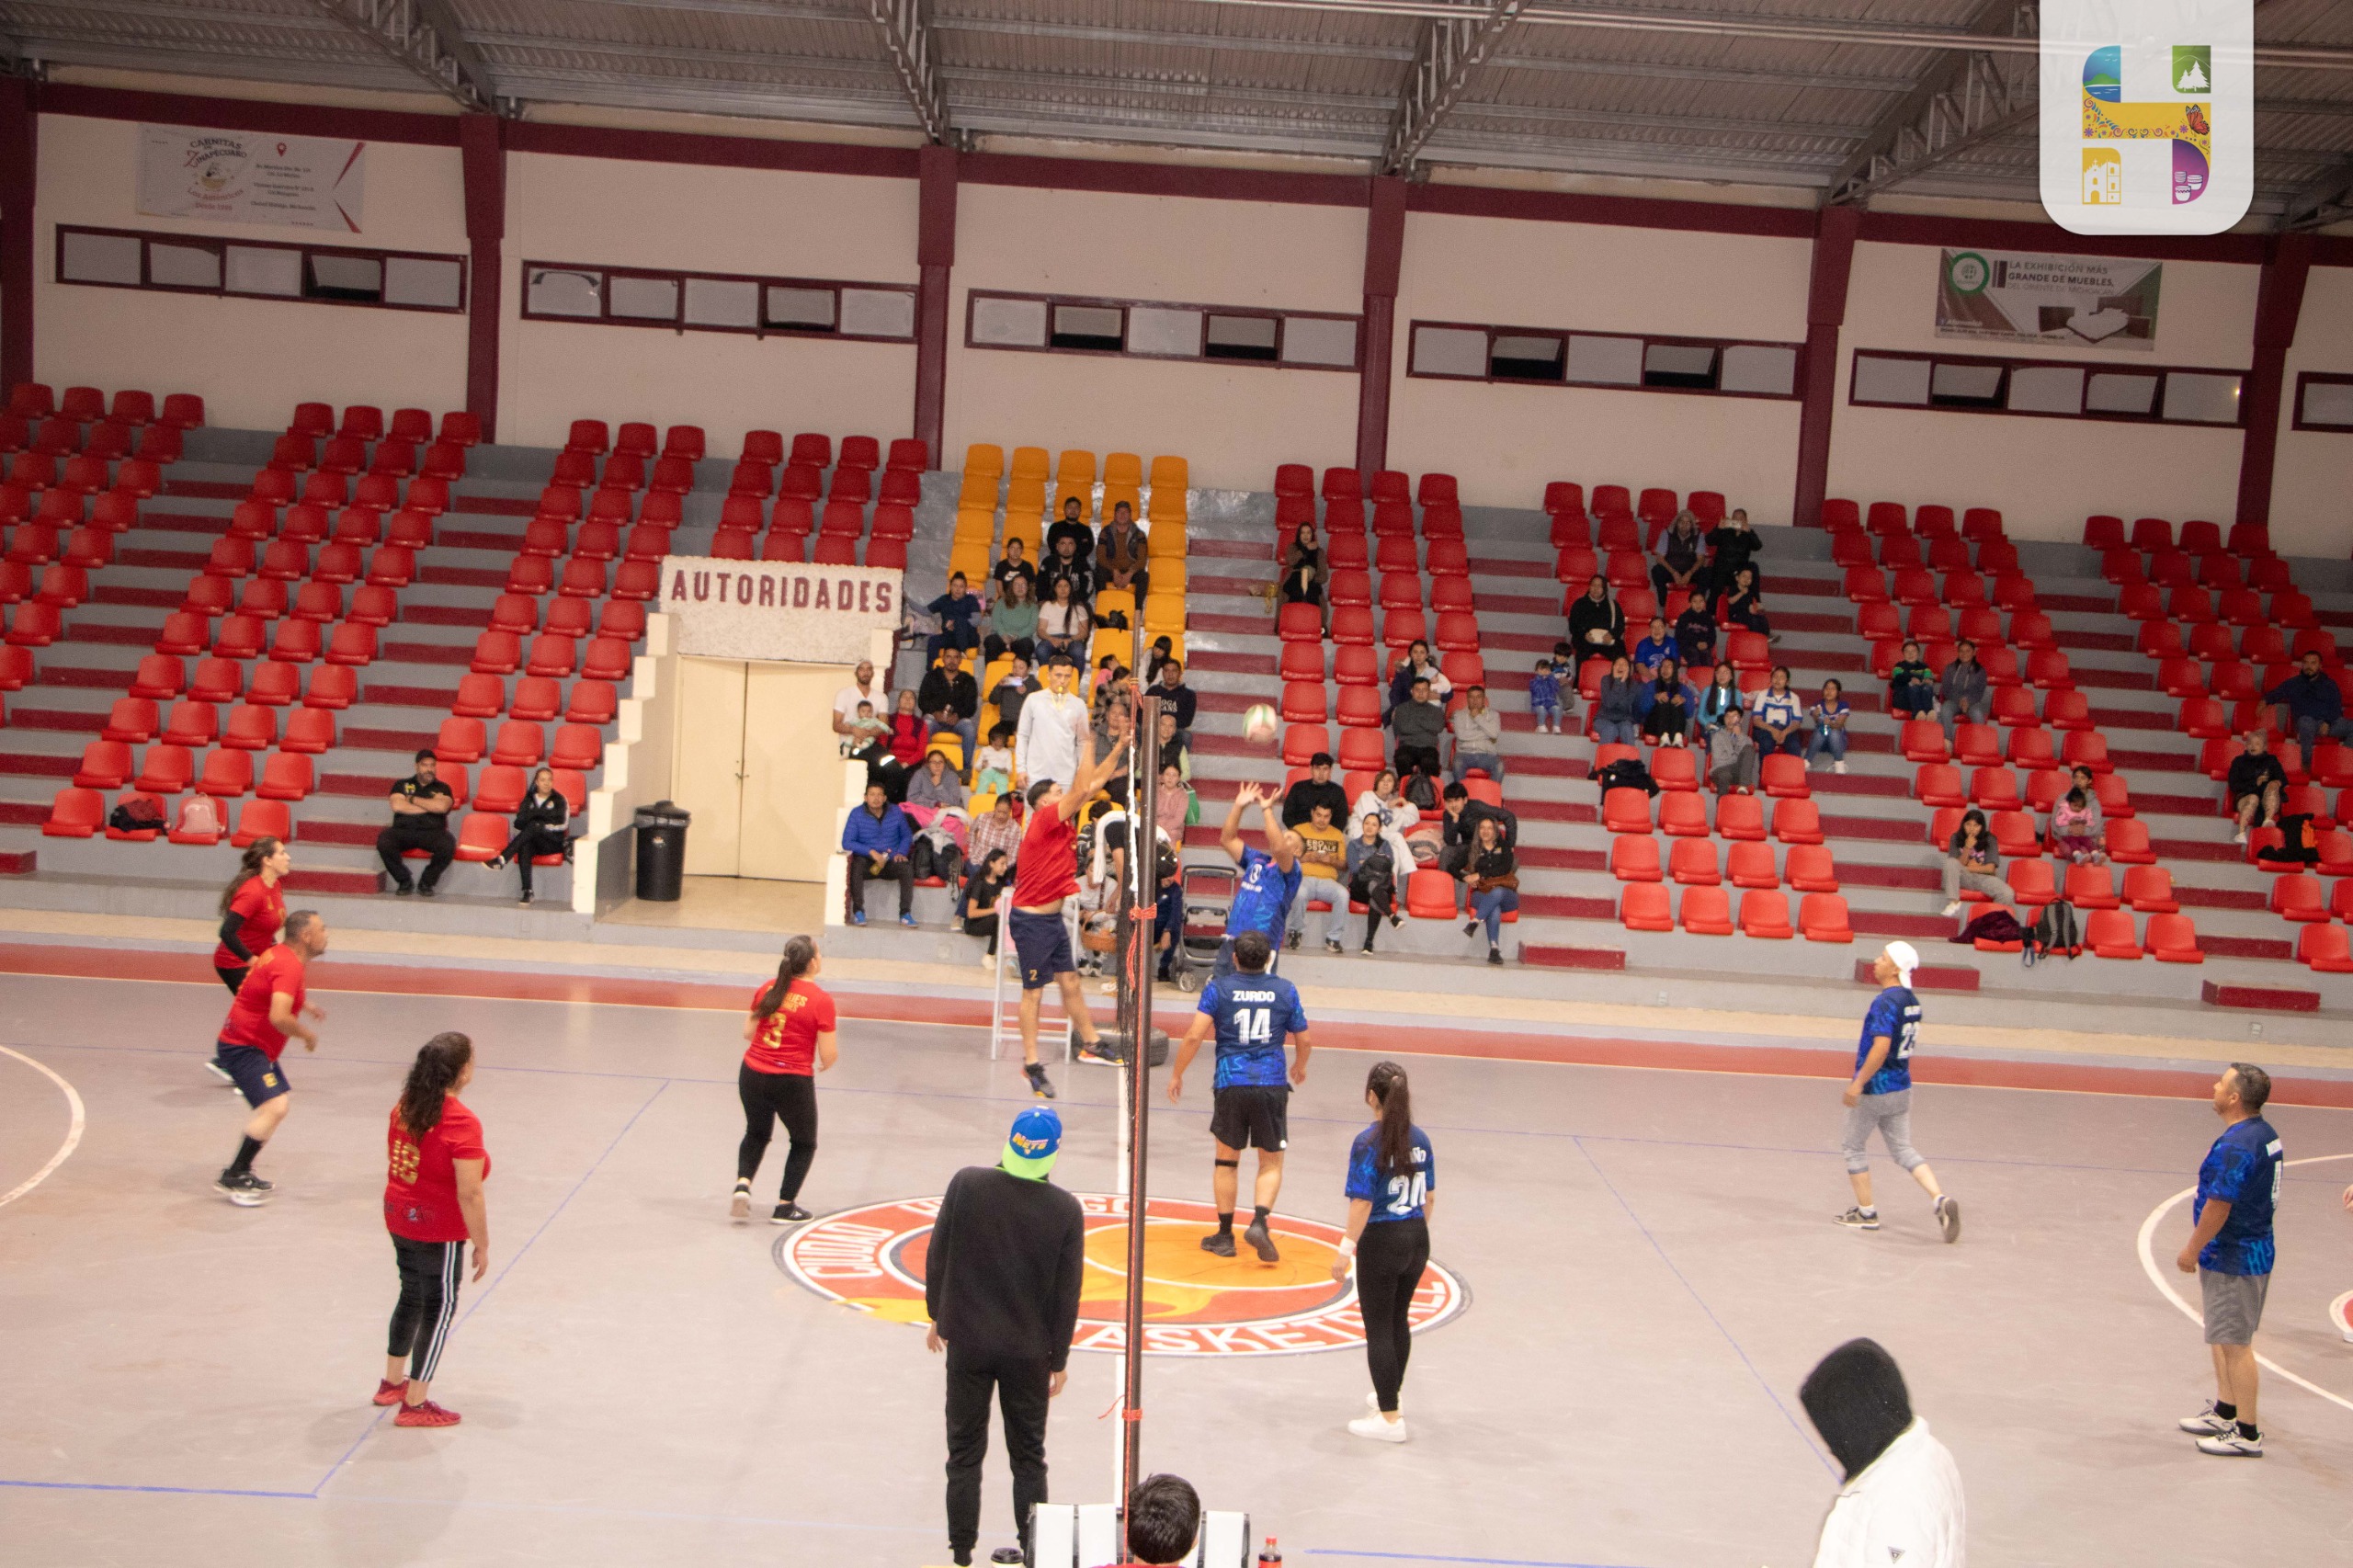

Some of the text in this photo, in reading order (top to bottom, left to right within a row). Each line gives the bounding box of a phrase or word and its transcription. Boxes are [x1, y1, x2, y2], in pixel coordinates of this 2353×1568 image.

[2008, 272, 2049, 282] GRANDE
[2052, 274, 2065, 283] DE
[2009, 261, 2109, 275] LA EXHIBICIÓN MÁS
[671, 570, 892, 613] AUTORIDADES
[1233, 990, 1276, 1002] ZURDO
[764, 1012, 786, 1049] 3
[1233, 1008, 1273, 1044] 14
[796, 1221, 894, 1278] CIUDAD
